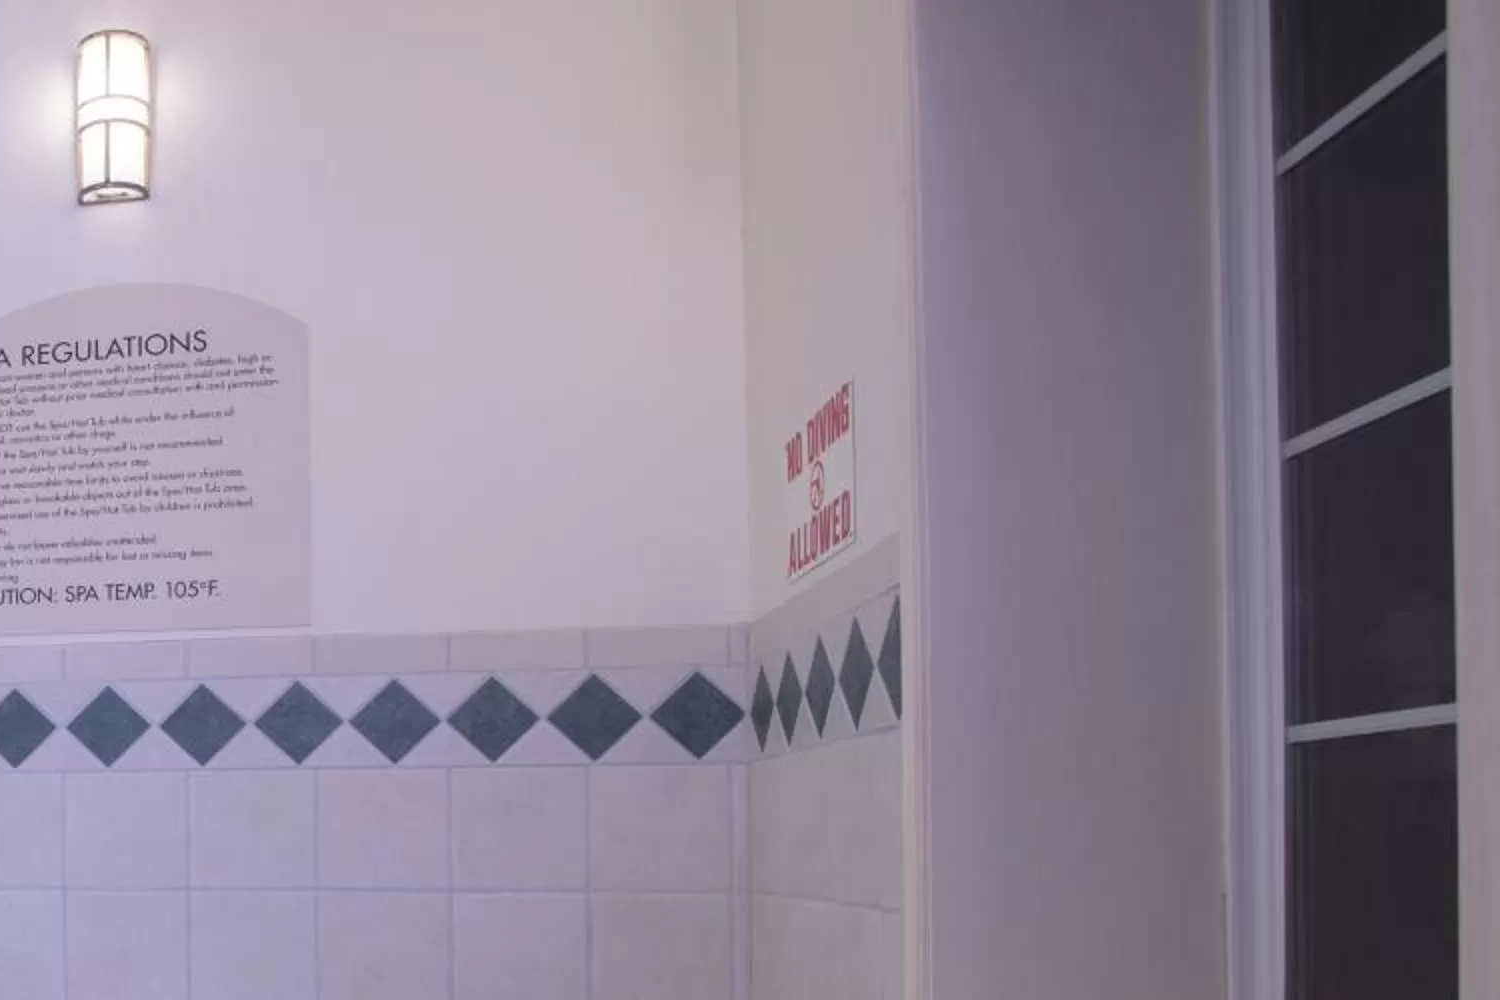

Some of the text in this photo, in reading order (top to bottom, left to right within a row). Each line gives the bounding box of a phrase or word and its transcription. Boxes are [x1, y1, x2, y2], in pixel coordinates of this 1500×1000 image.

[21, 329, 208, 367] REGULATIONS
[784, 382, 850, 484] NO DIVING
[787, 490, 851, 578] ALLOWED
[65, 585, 100, 603] SPA
[106, 583, 156, 601] TEMP.
